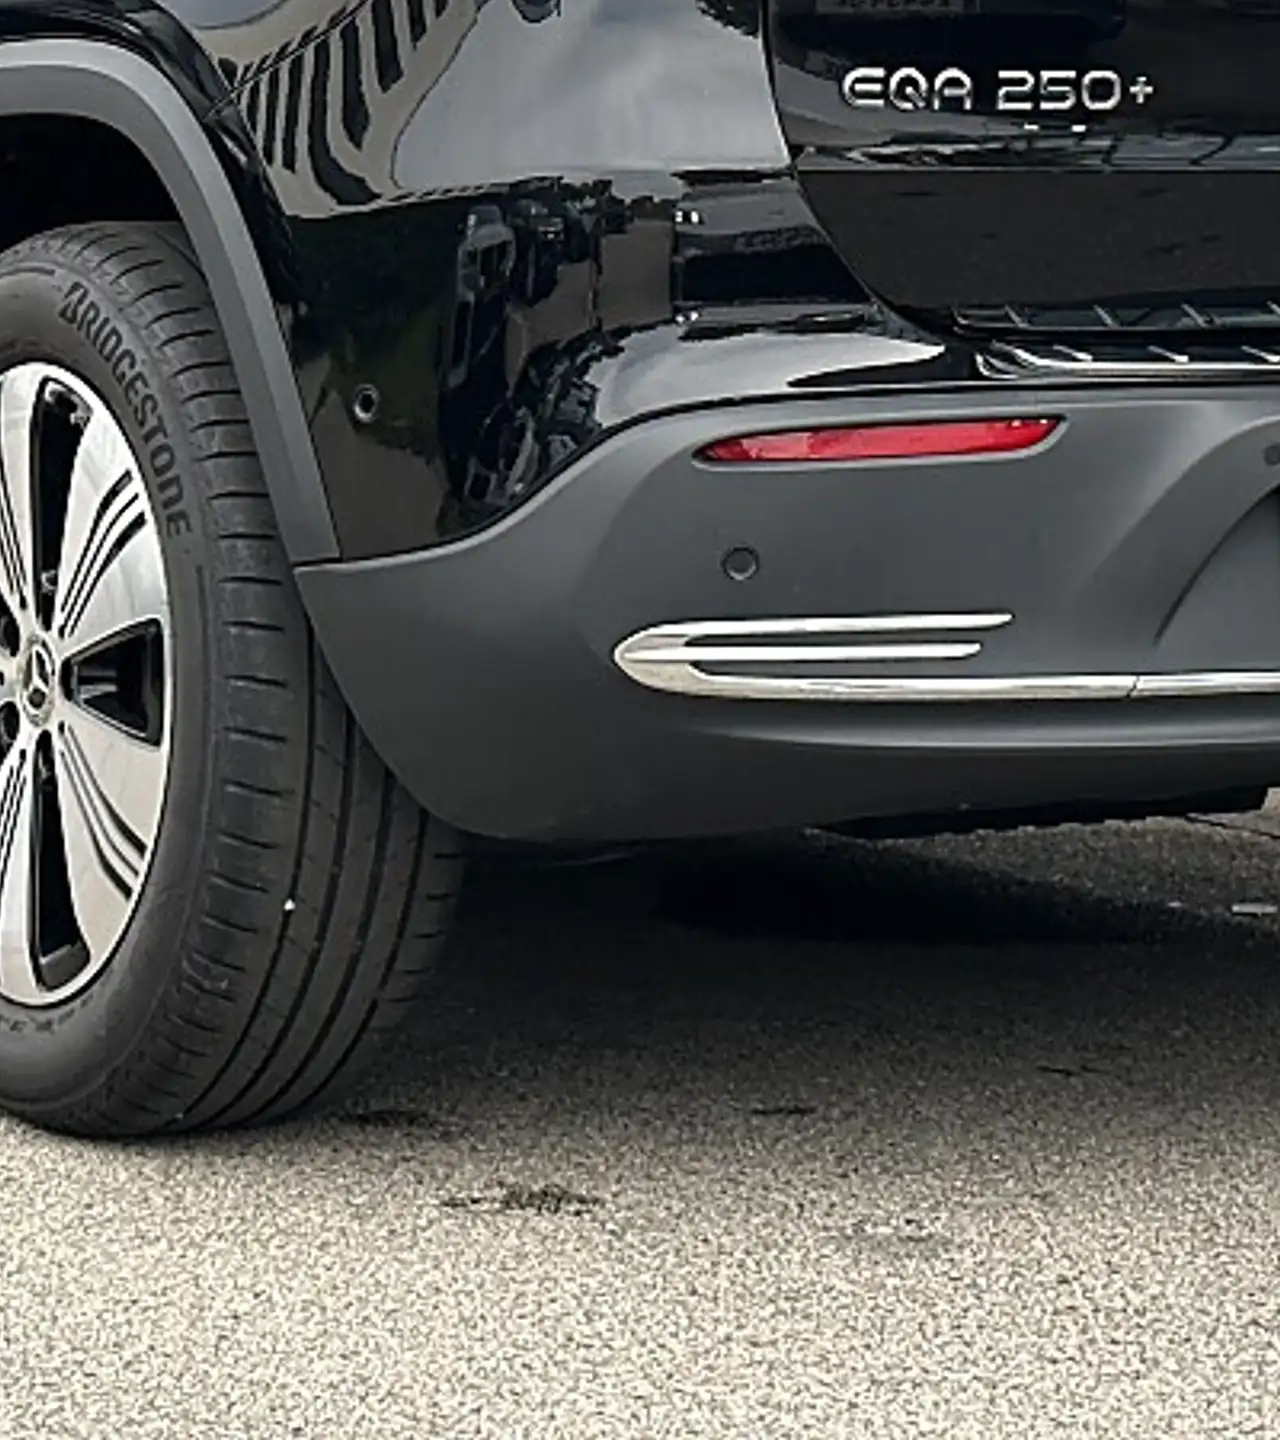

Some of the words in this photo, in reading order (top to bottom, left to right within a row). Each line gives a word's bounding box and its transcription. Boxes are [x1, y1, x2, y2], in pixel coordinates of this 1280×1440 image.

[841, 66, 974, 111] EQA
[996, 68, 1154, 111] 250+
[58, 280, 192, 537] BRIDGESTONE
